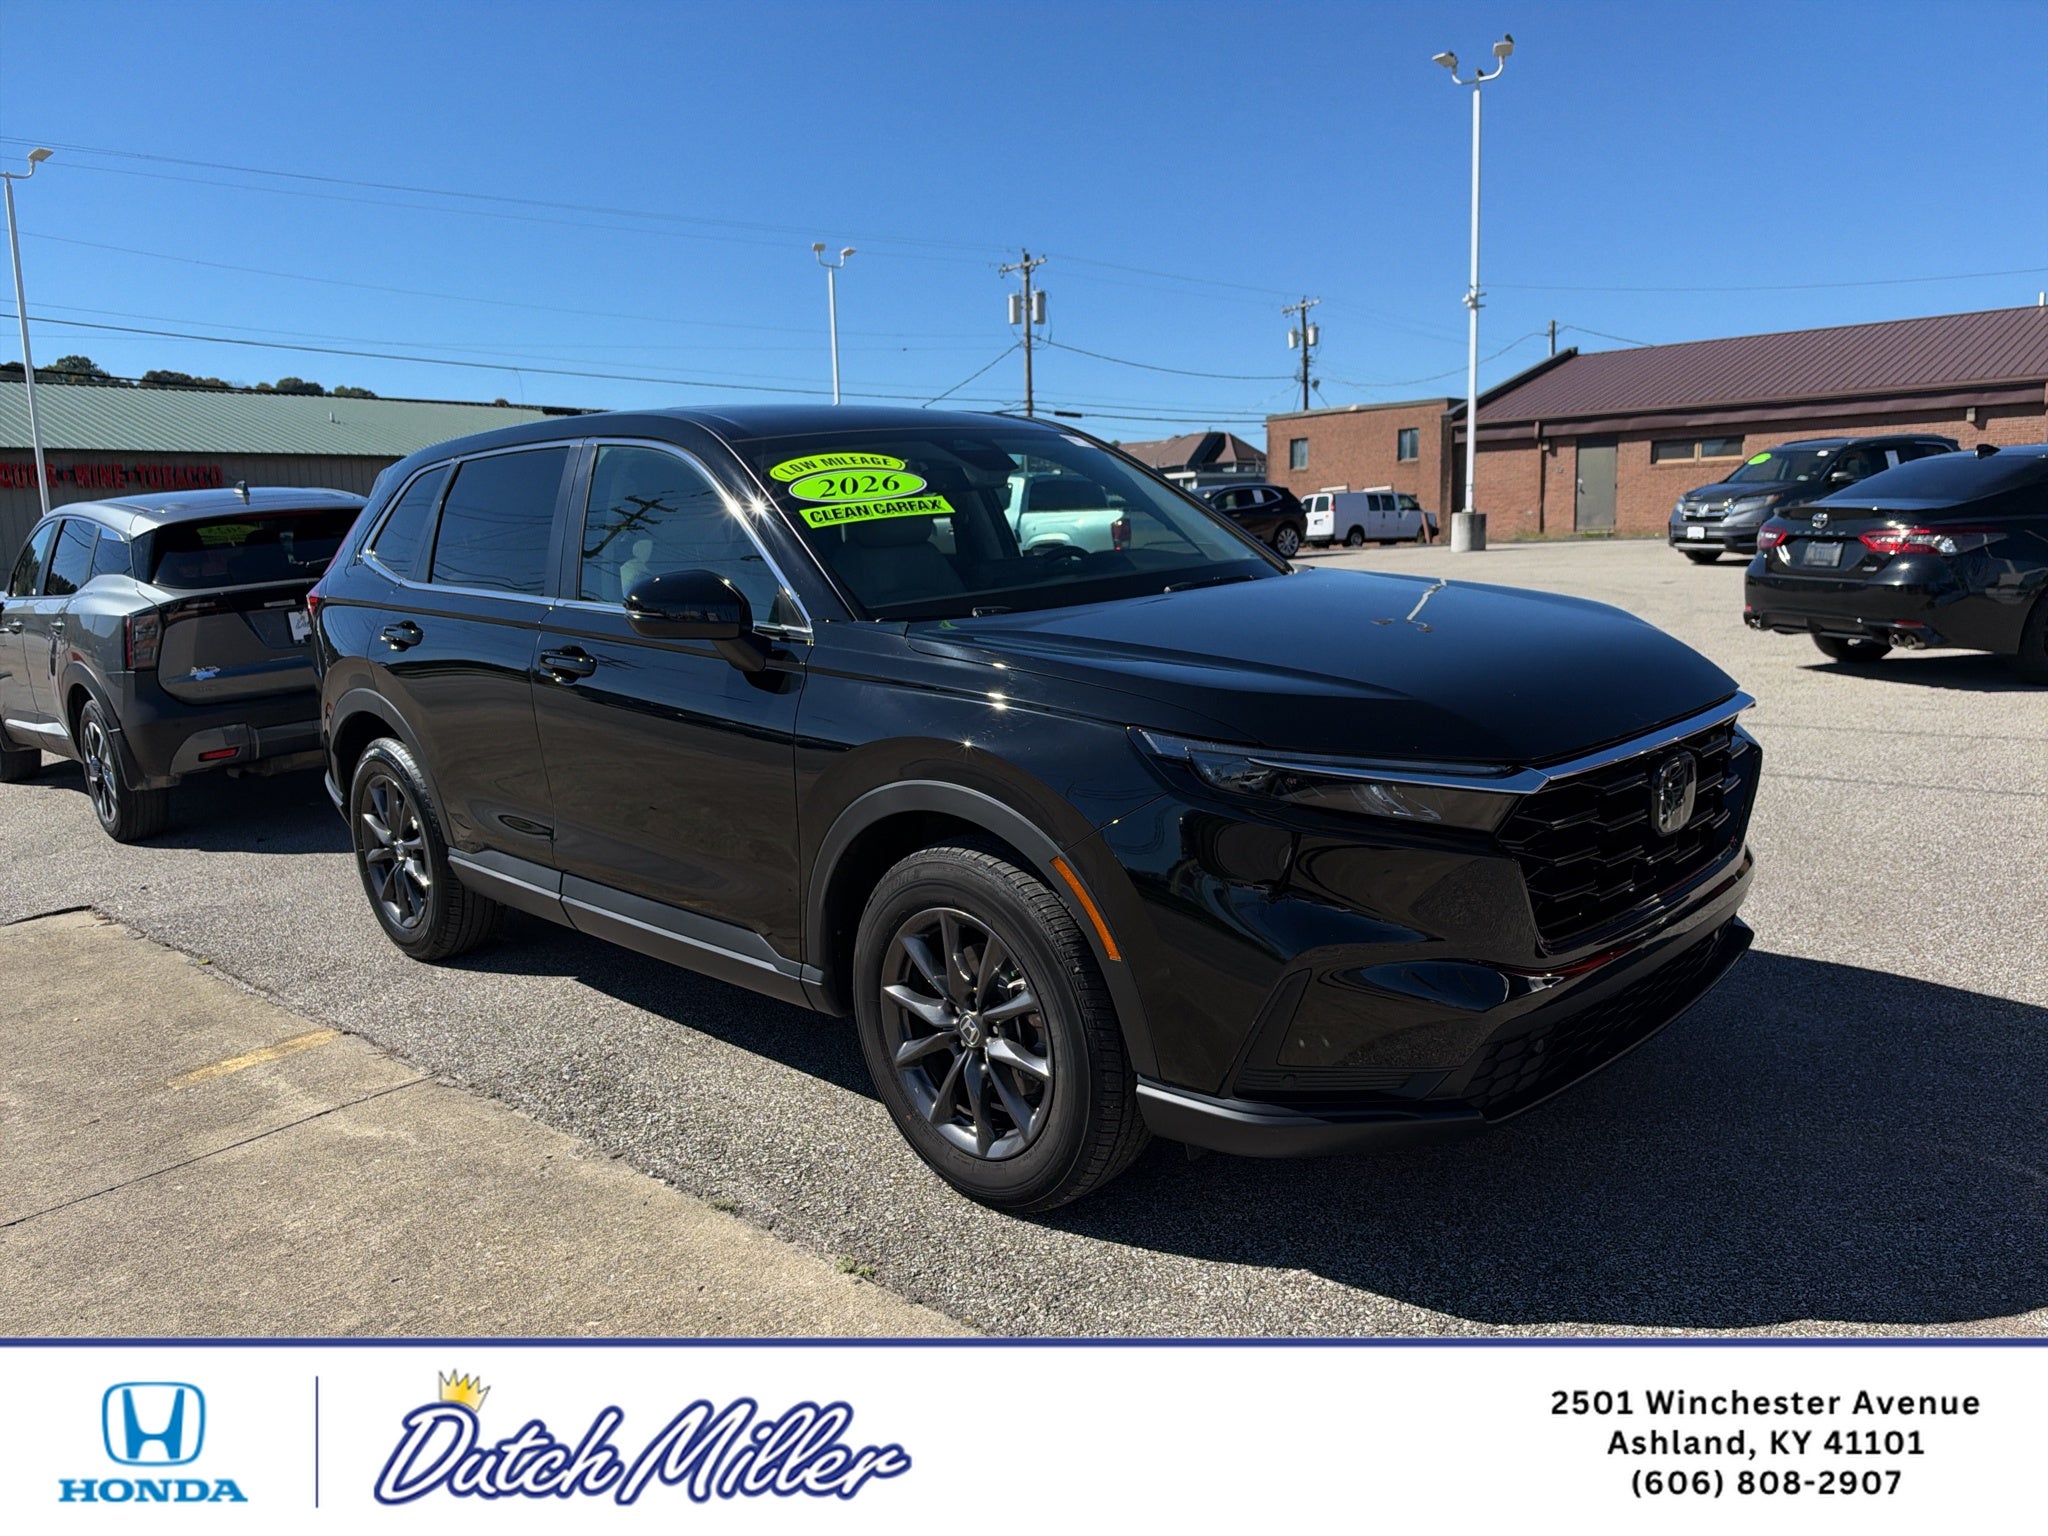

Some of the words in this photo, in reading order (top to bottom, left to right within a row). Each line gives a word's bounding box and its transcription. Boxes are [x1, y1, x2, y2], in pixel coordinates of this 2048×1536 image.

[73, 463, 126, 489] WINE
[135, 463, 224, 489] TOBACCO
[782, 459, 818, 476] LOW
[819, 455, 892, 468] MILEAGE
[817, 474, 901, 499] 2026
[809, 503, 870, 524] CLEAN
[872, 499, 942, 516] CARFAX
